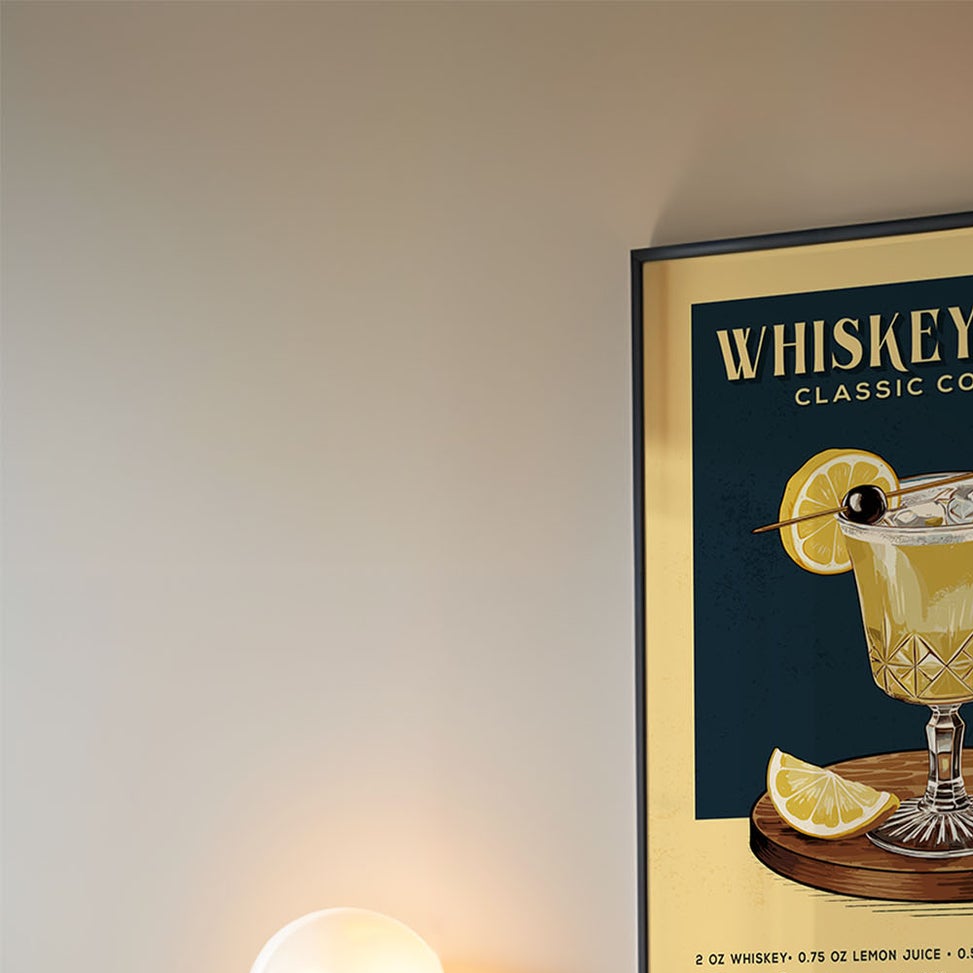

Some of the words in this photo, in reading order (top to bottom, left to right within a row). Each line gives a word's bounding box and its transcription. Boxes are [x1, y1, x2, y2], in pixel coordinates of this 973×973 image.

[795, 377, 923, 406] CLASSIC
[695, 954, 703, 966] 2
[708, 953, 725, 966] OZ
[798, 951, 826, 964] 0.75
[830, 950, 848, 963] OZ
[852, 949, 897, 962] LEMON
[902, 948, 941, 961] JUICE
